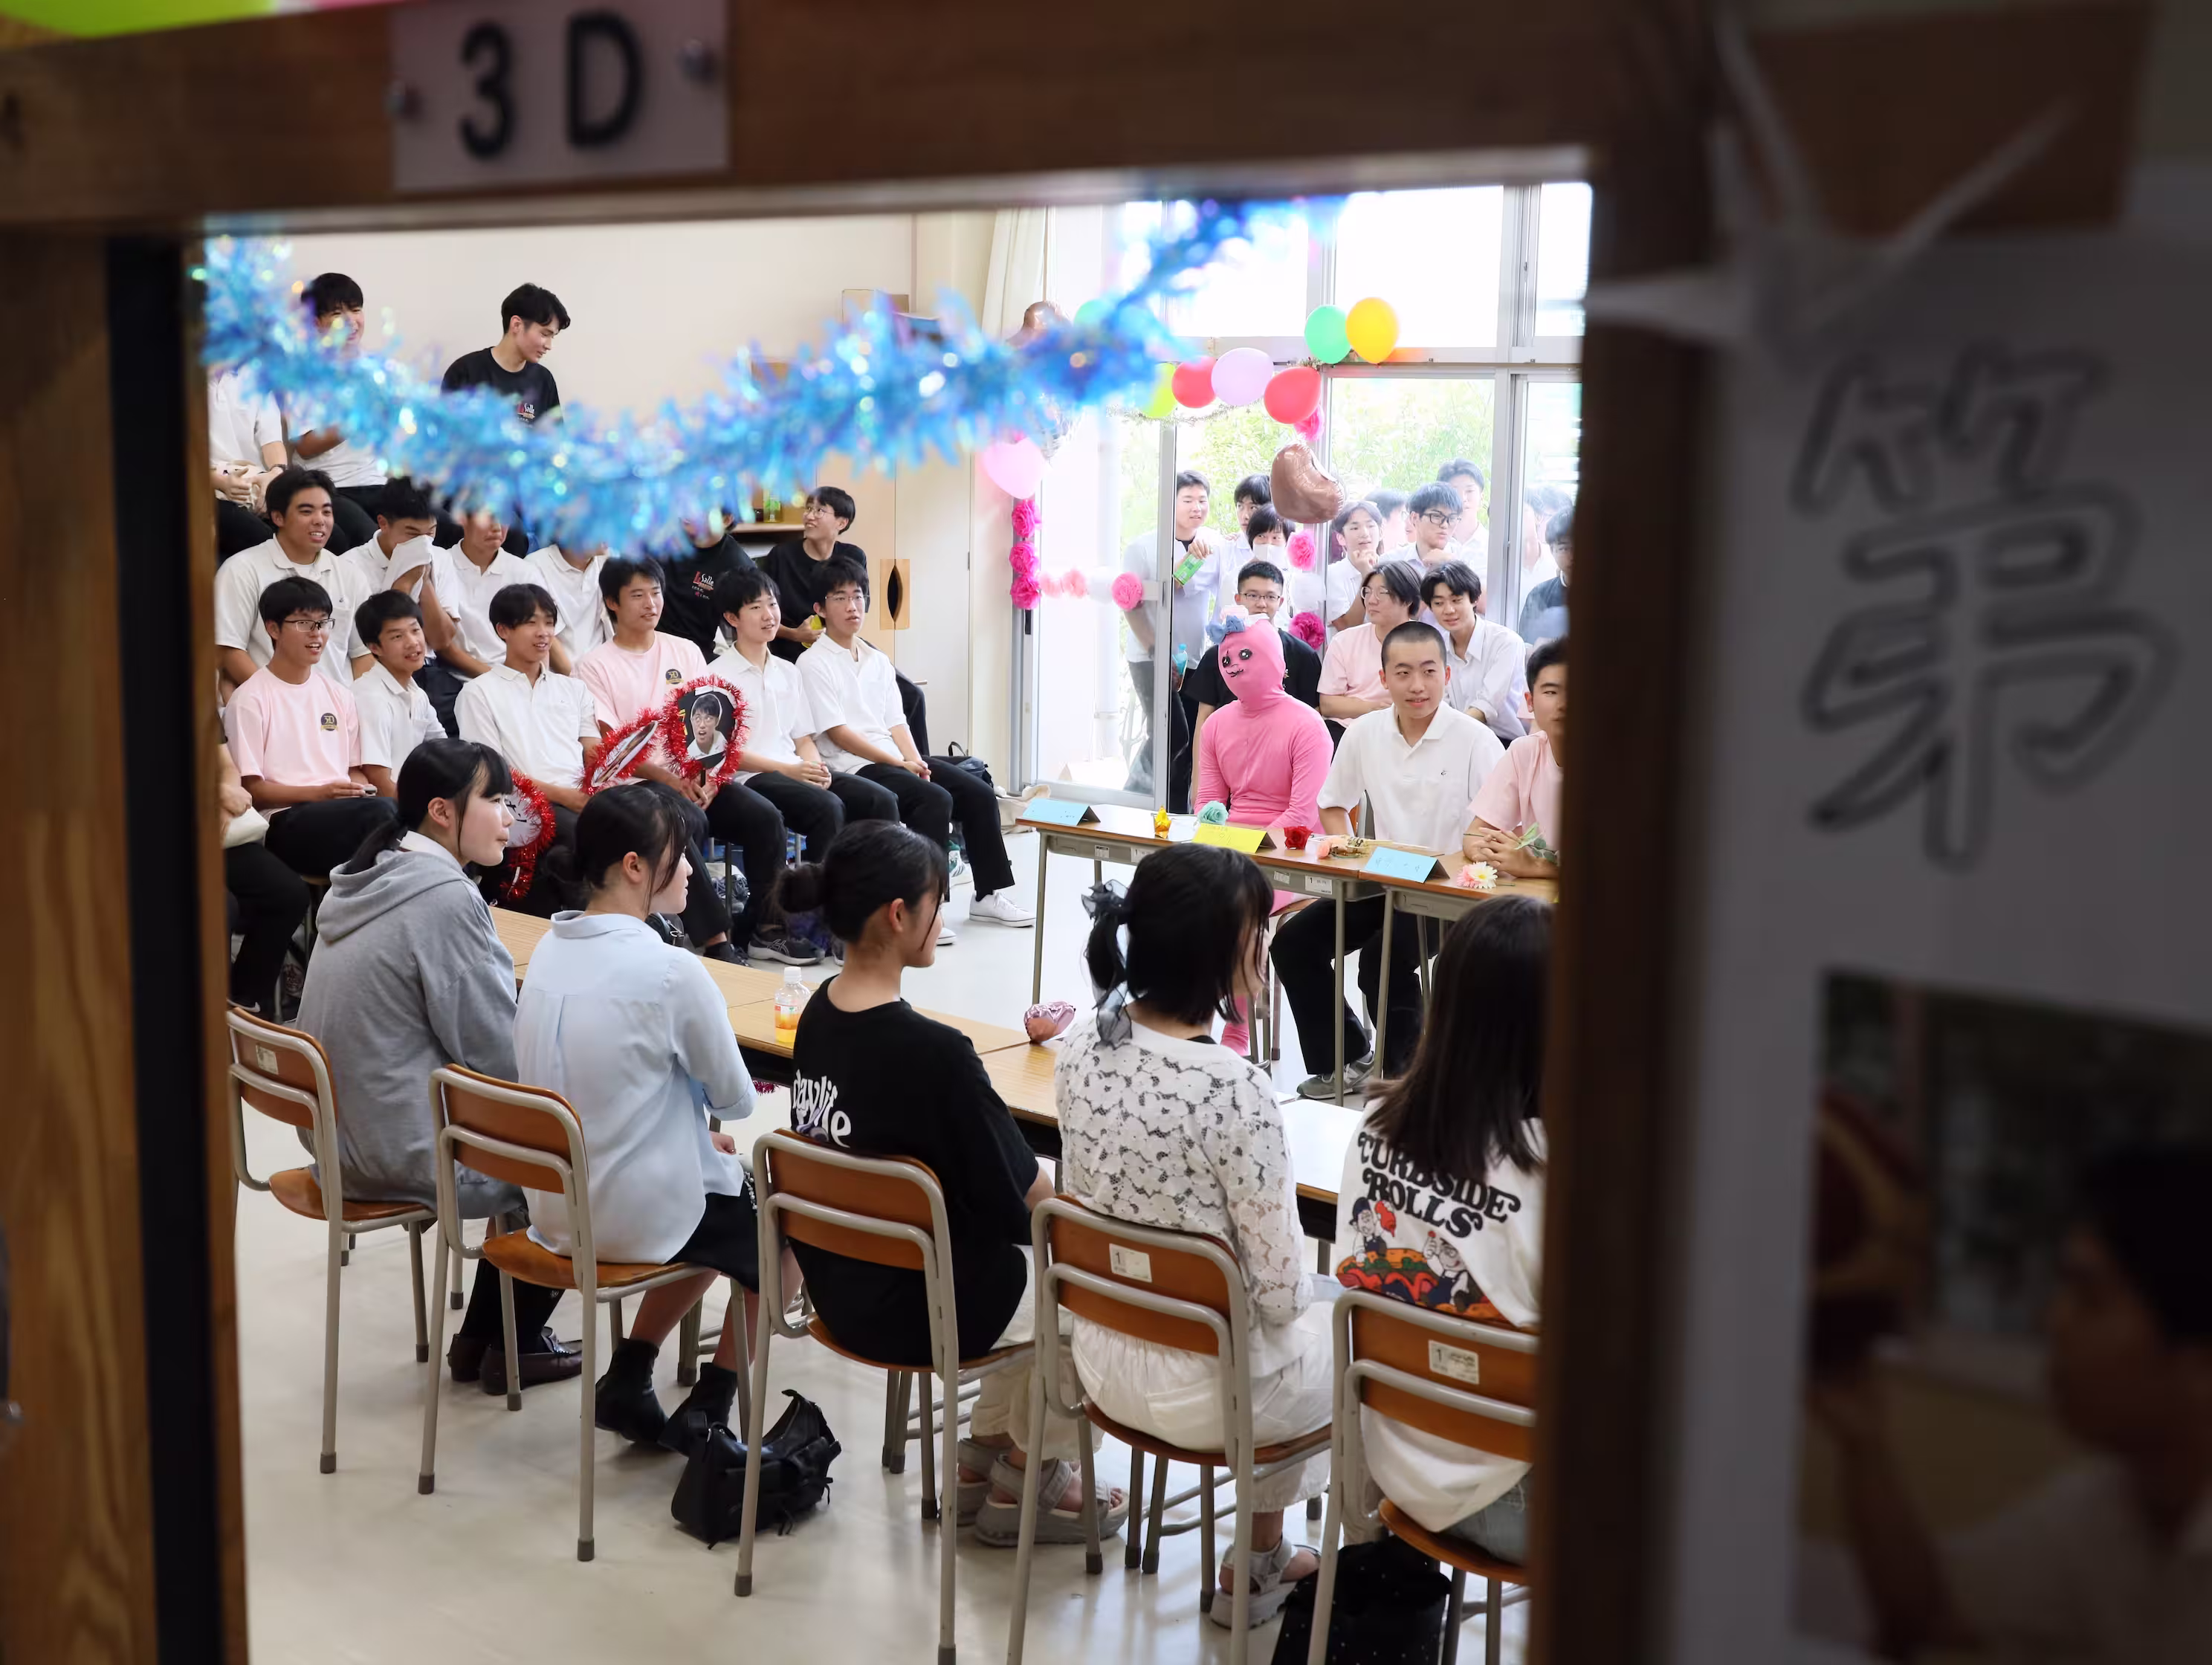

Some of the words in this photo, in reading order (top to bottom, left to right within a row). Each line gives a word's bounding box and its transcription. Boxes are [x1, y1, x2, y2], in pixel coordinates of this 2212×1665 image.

[701, 573, 714, 586] Salle
[1788, 338, 2185, 876] 第
[1362, 1168, 1483, 1238] ROLLS
